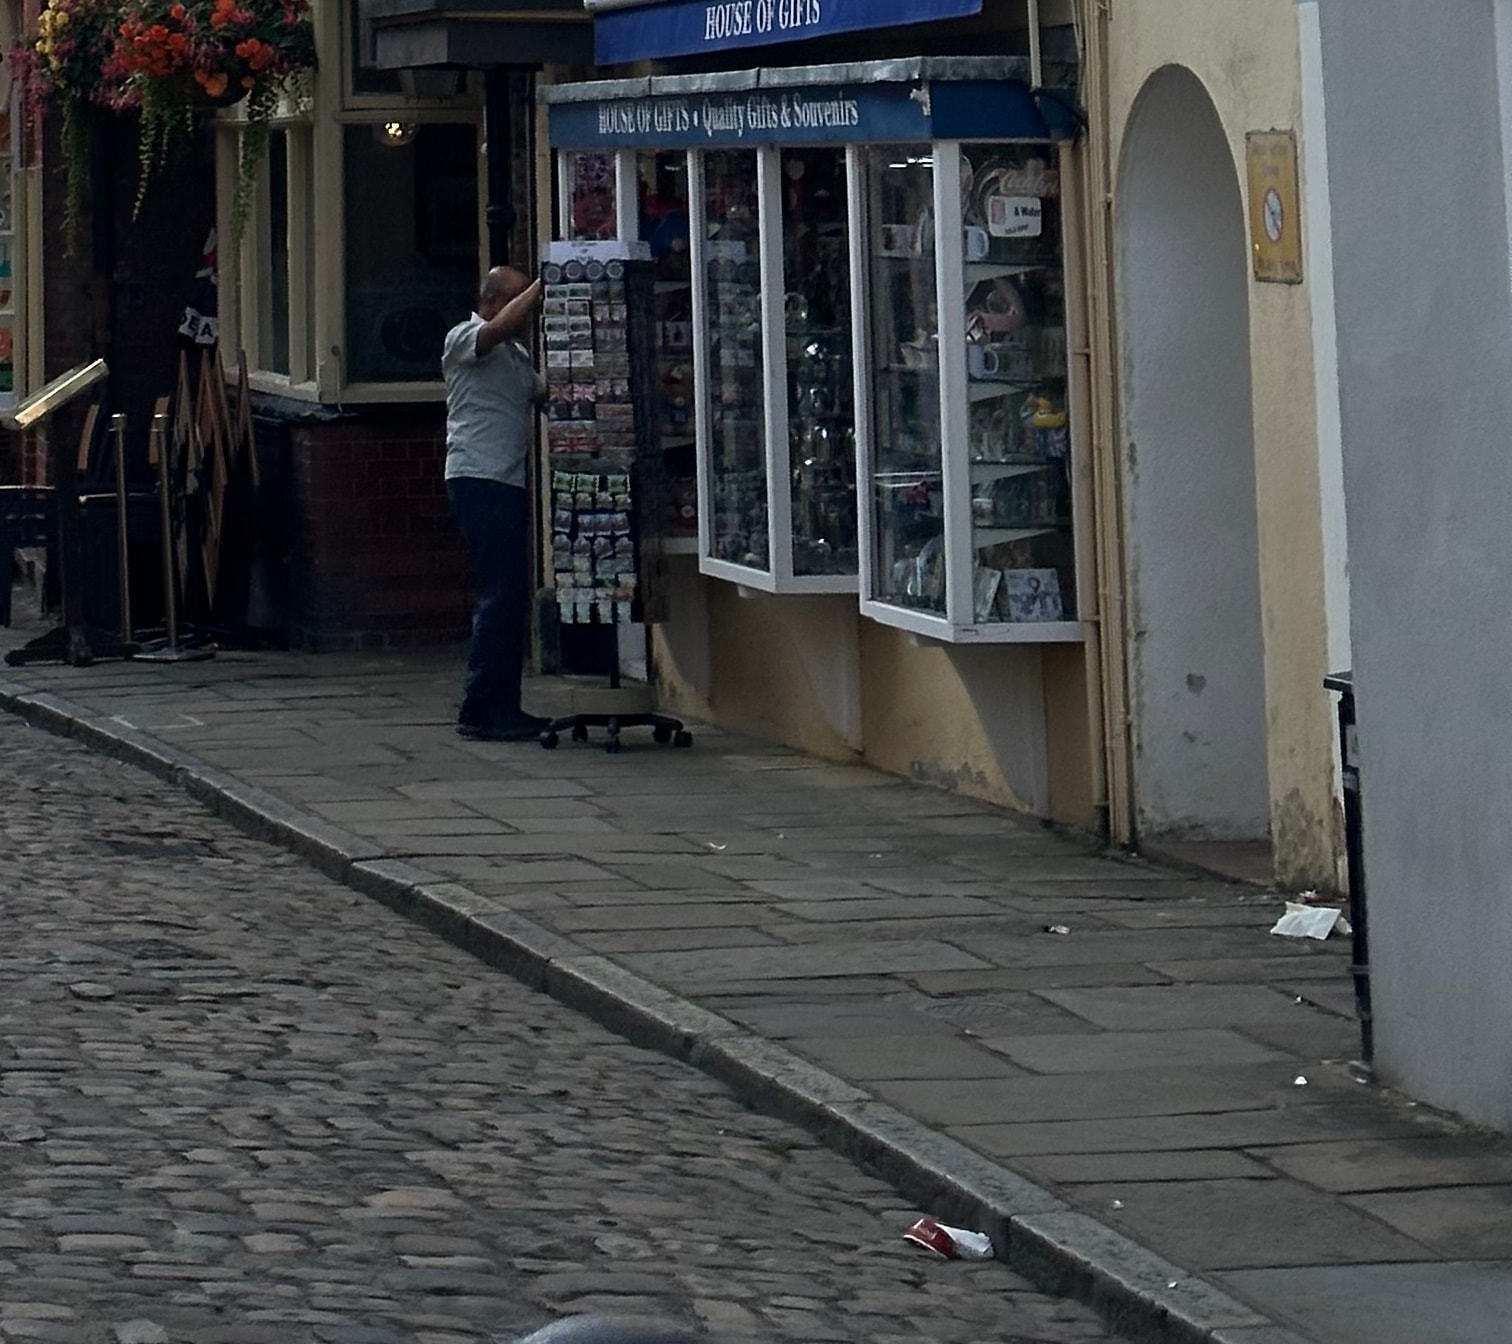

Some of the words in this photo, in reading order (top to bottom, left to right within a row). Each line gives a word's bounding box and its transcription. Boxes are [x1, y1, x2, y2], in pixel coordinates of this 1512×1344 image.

[704, 0, 752, 40] HOUSE
[599, 102, 636, 134] HOUSE
[637, 101, 652, 132] OF
[654, 99, 689, 132] GIFTS
[702, 97, 744, 137] Quality
[748, 96, 778, 130] Gifts
[780, 94, 791, 128] &
[793, 91, 859, 128] Souvenirs
